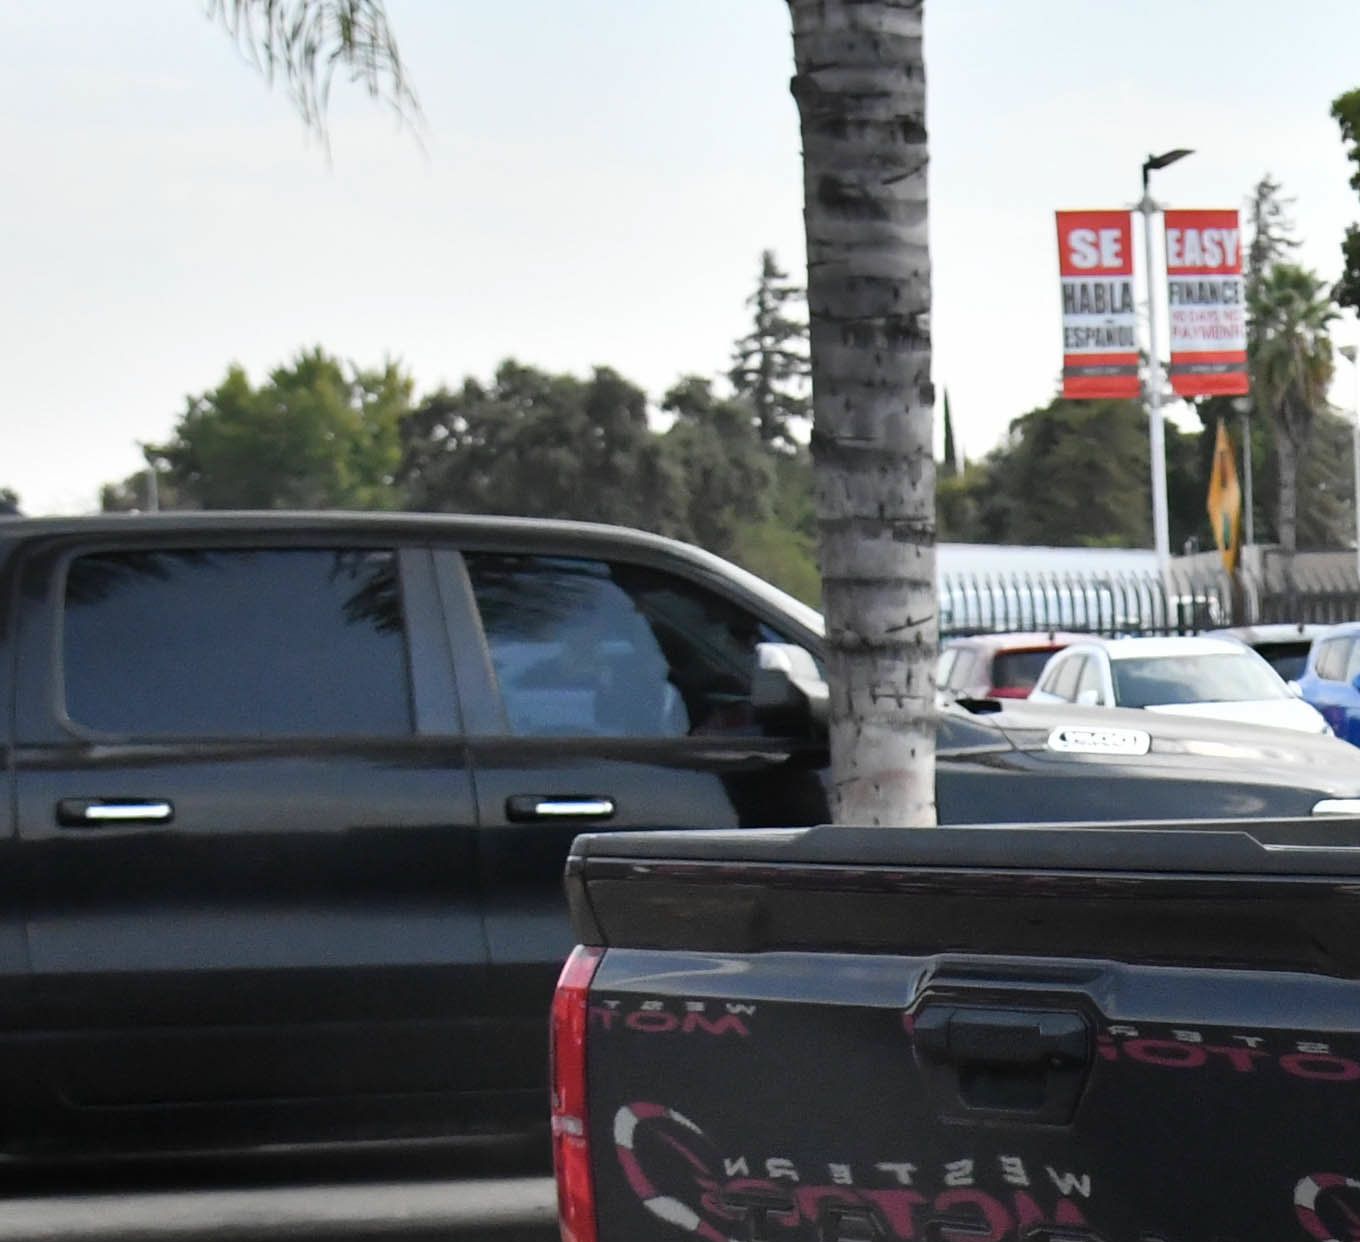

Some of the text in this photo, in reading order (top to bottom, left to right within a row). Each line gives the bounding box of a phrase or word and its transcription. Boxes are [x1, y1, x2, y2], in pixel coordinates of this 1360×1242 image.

[1068, 228, 1123, 269] SE
[1167, 227, 1240, 268] EASY
[1063, 282, 1135, 315] HABLA
[1169, 281, 1239, 304] FINANCE
